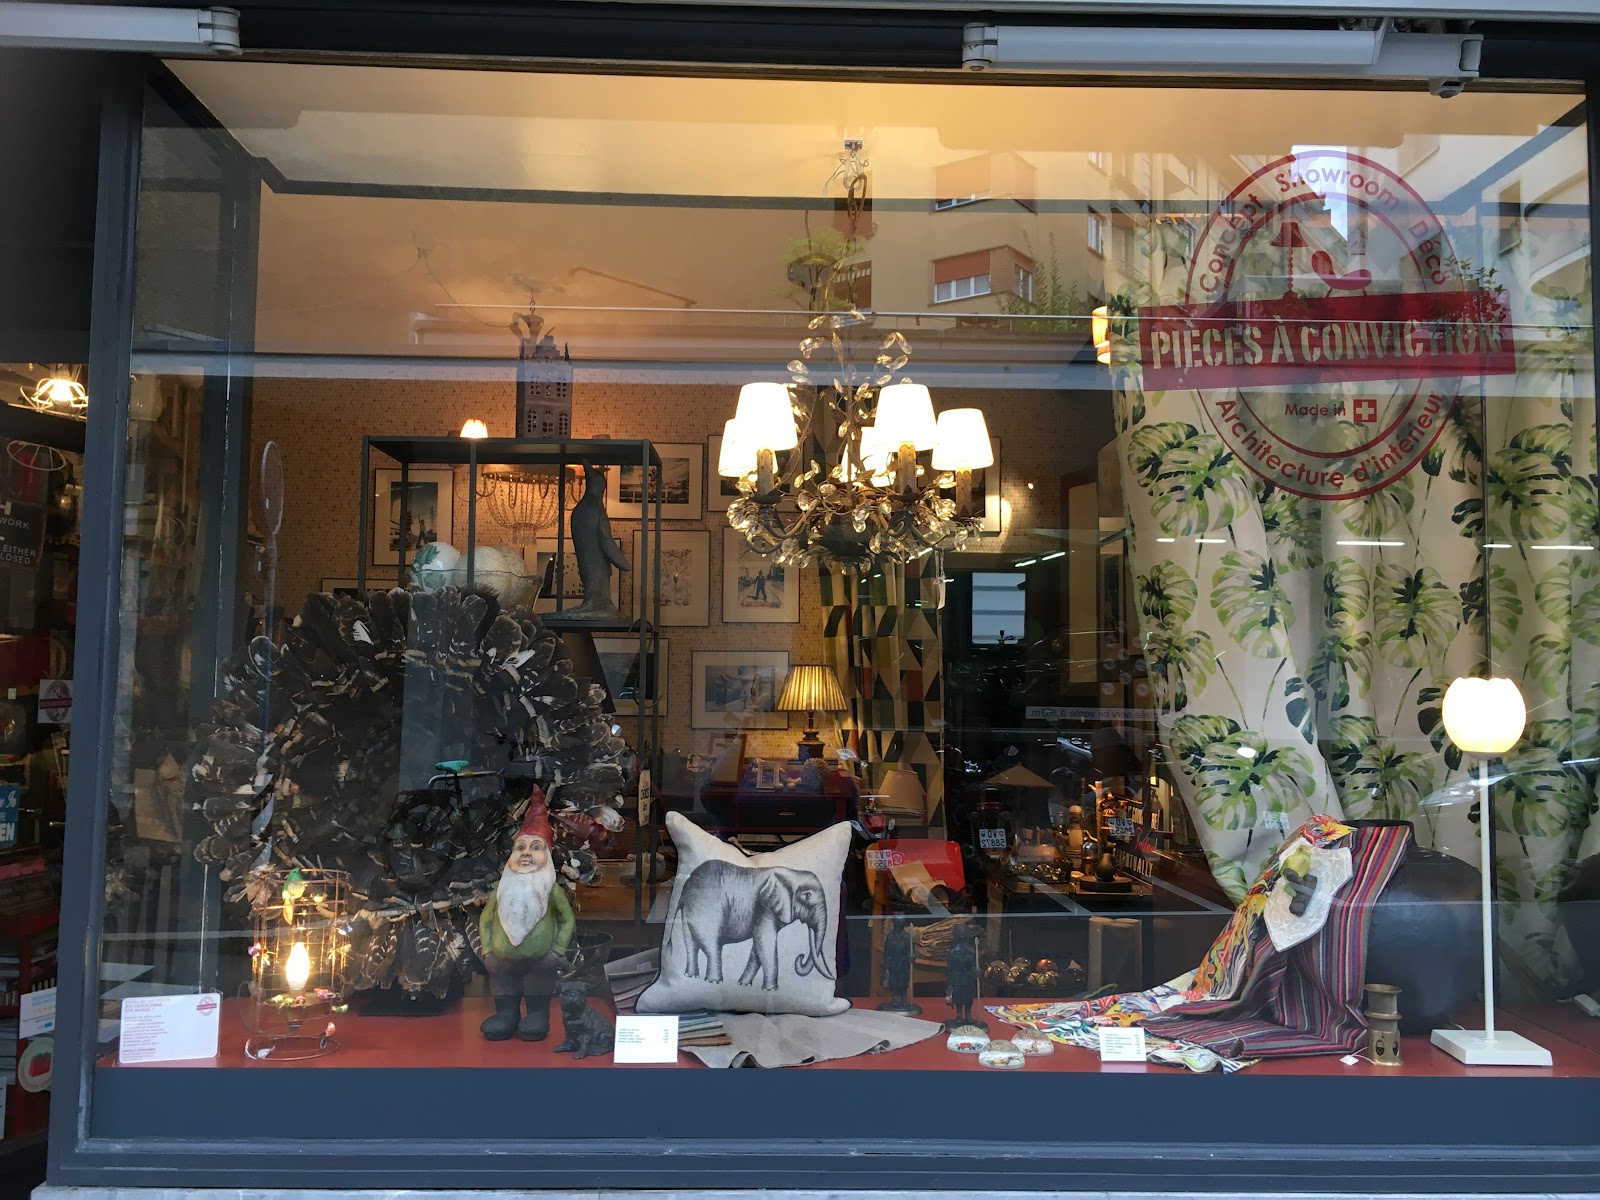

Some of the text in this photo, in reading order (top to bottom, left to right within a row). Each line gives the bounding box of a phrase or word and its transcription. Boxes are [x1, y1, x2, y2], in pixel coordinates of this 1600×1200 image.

[1199, 165, 1446, 293] Concept Showroom Déco
[1150, 314, 1503, 370] PIÈCES À CONVICTION
[1284, 403, 1347, 417] Made in
[1215, 391, 1444, 487] Architecture d'intérieur
[0, 552, 31, 565] LOSED
[2, 544, 36, 558] EITHER
